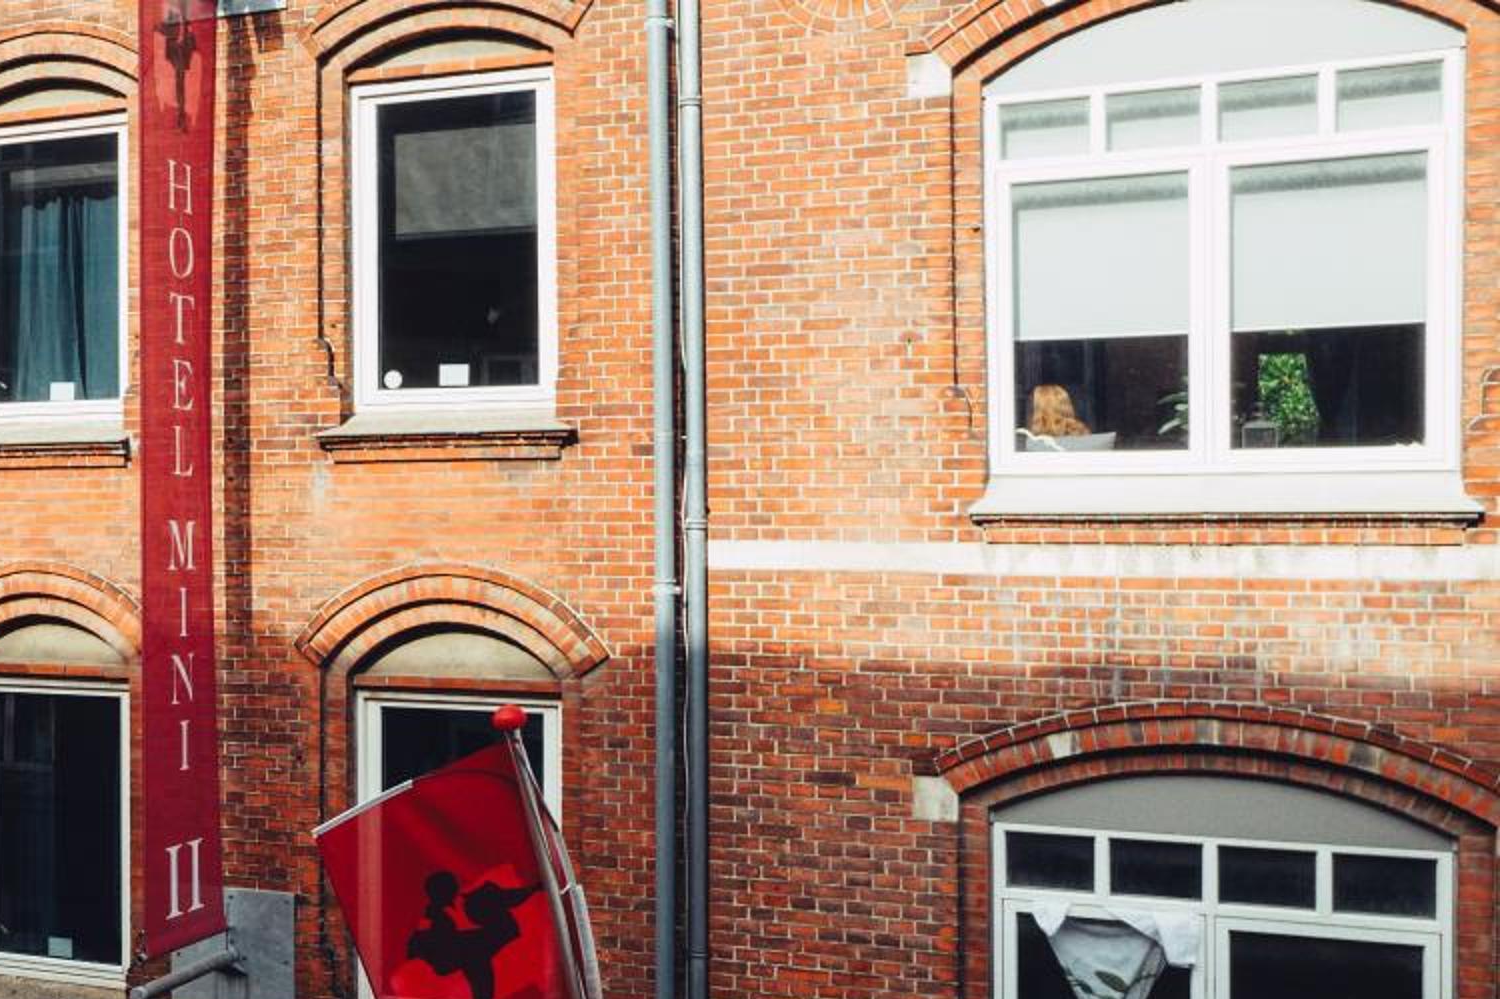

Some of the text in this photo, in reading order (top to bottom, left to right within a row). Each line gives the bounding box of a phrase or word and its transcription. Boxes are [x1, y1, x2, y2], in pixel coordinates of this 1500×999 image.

[164, 158, 205, 920] HOTEL MINI II
